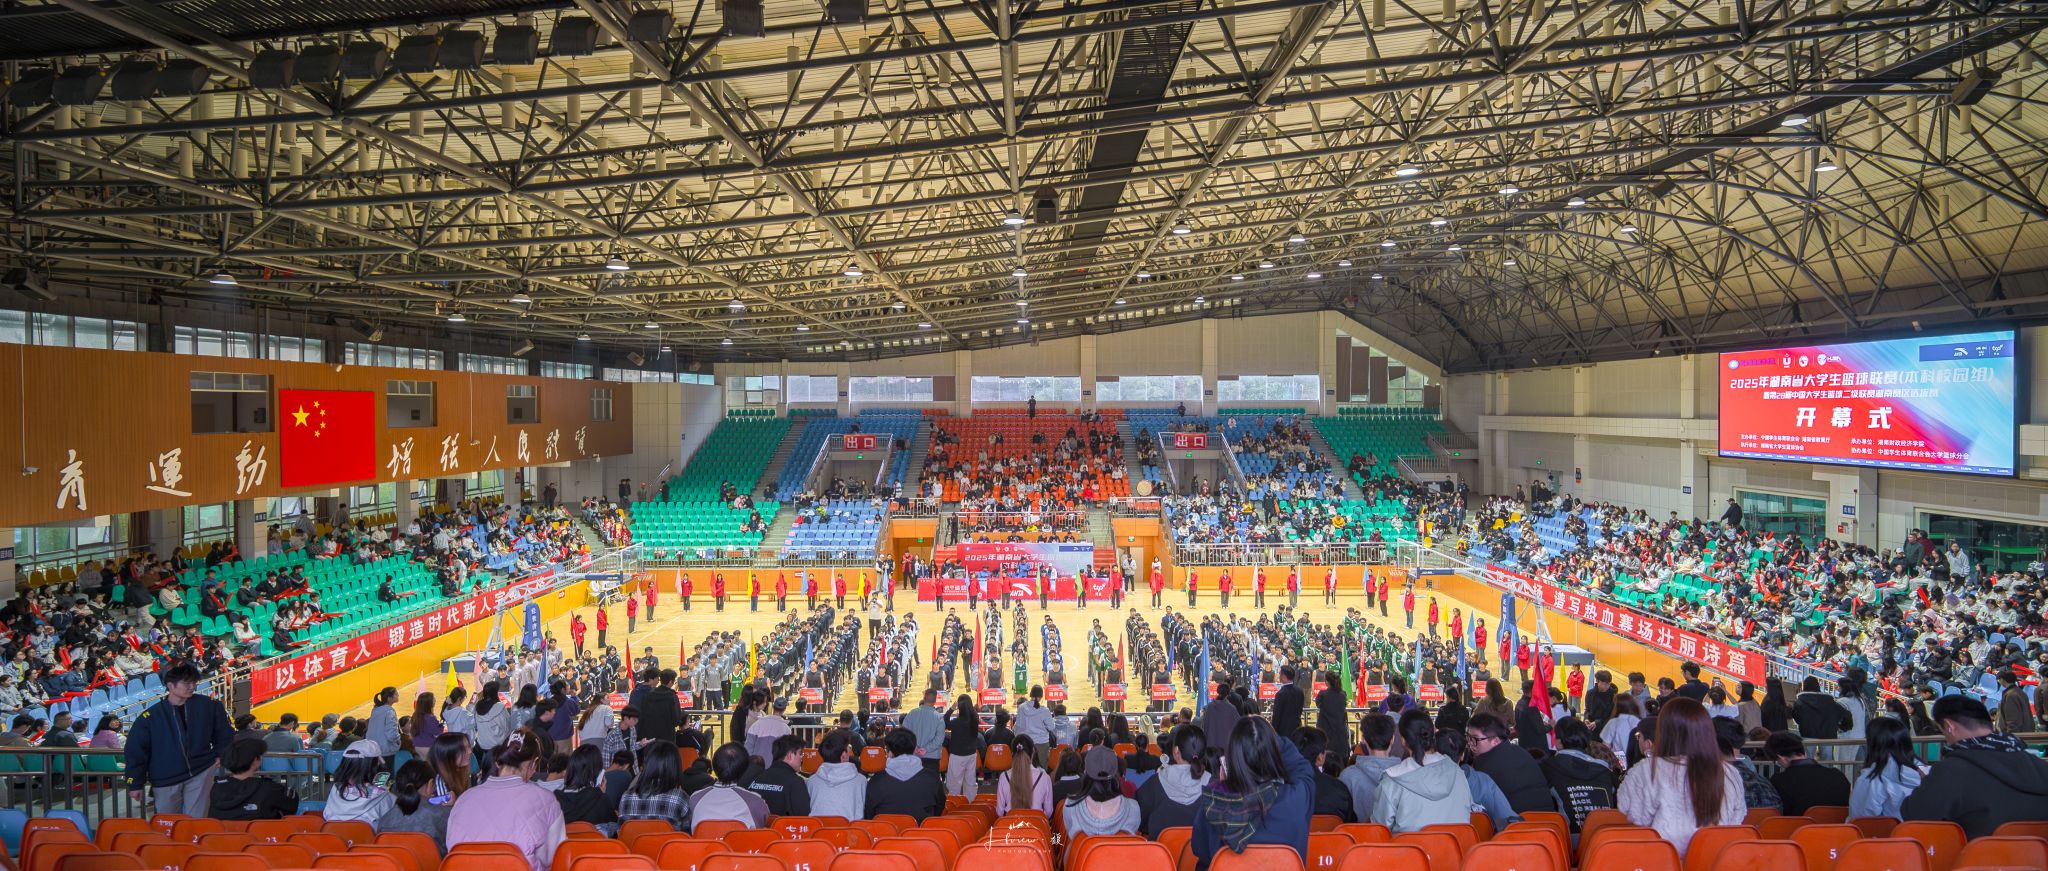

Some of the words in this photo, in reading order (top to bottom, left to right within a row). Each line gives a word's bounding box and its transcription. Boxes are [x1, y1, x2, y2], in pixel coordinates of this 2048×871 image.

[1796, 406, 1893, 429] 开幕式
[847, 436, 874, 449] 出口
[1177, 435, 1204, 447] 出口
[1554, 591, 1747, 676] 谱写热血赛场壮丽诗篇
[274, 639, 371, 690] 以体育人
[1829, 848, 1837, 860] 5
[1927, 846, 1935, 856] 4
[1317, 855, 1333, 866] 10
